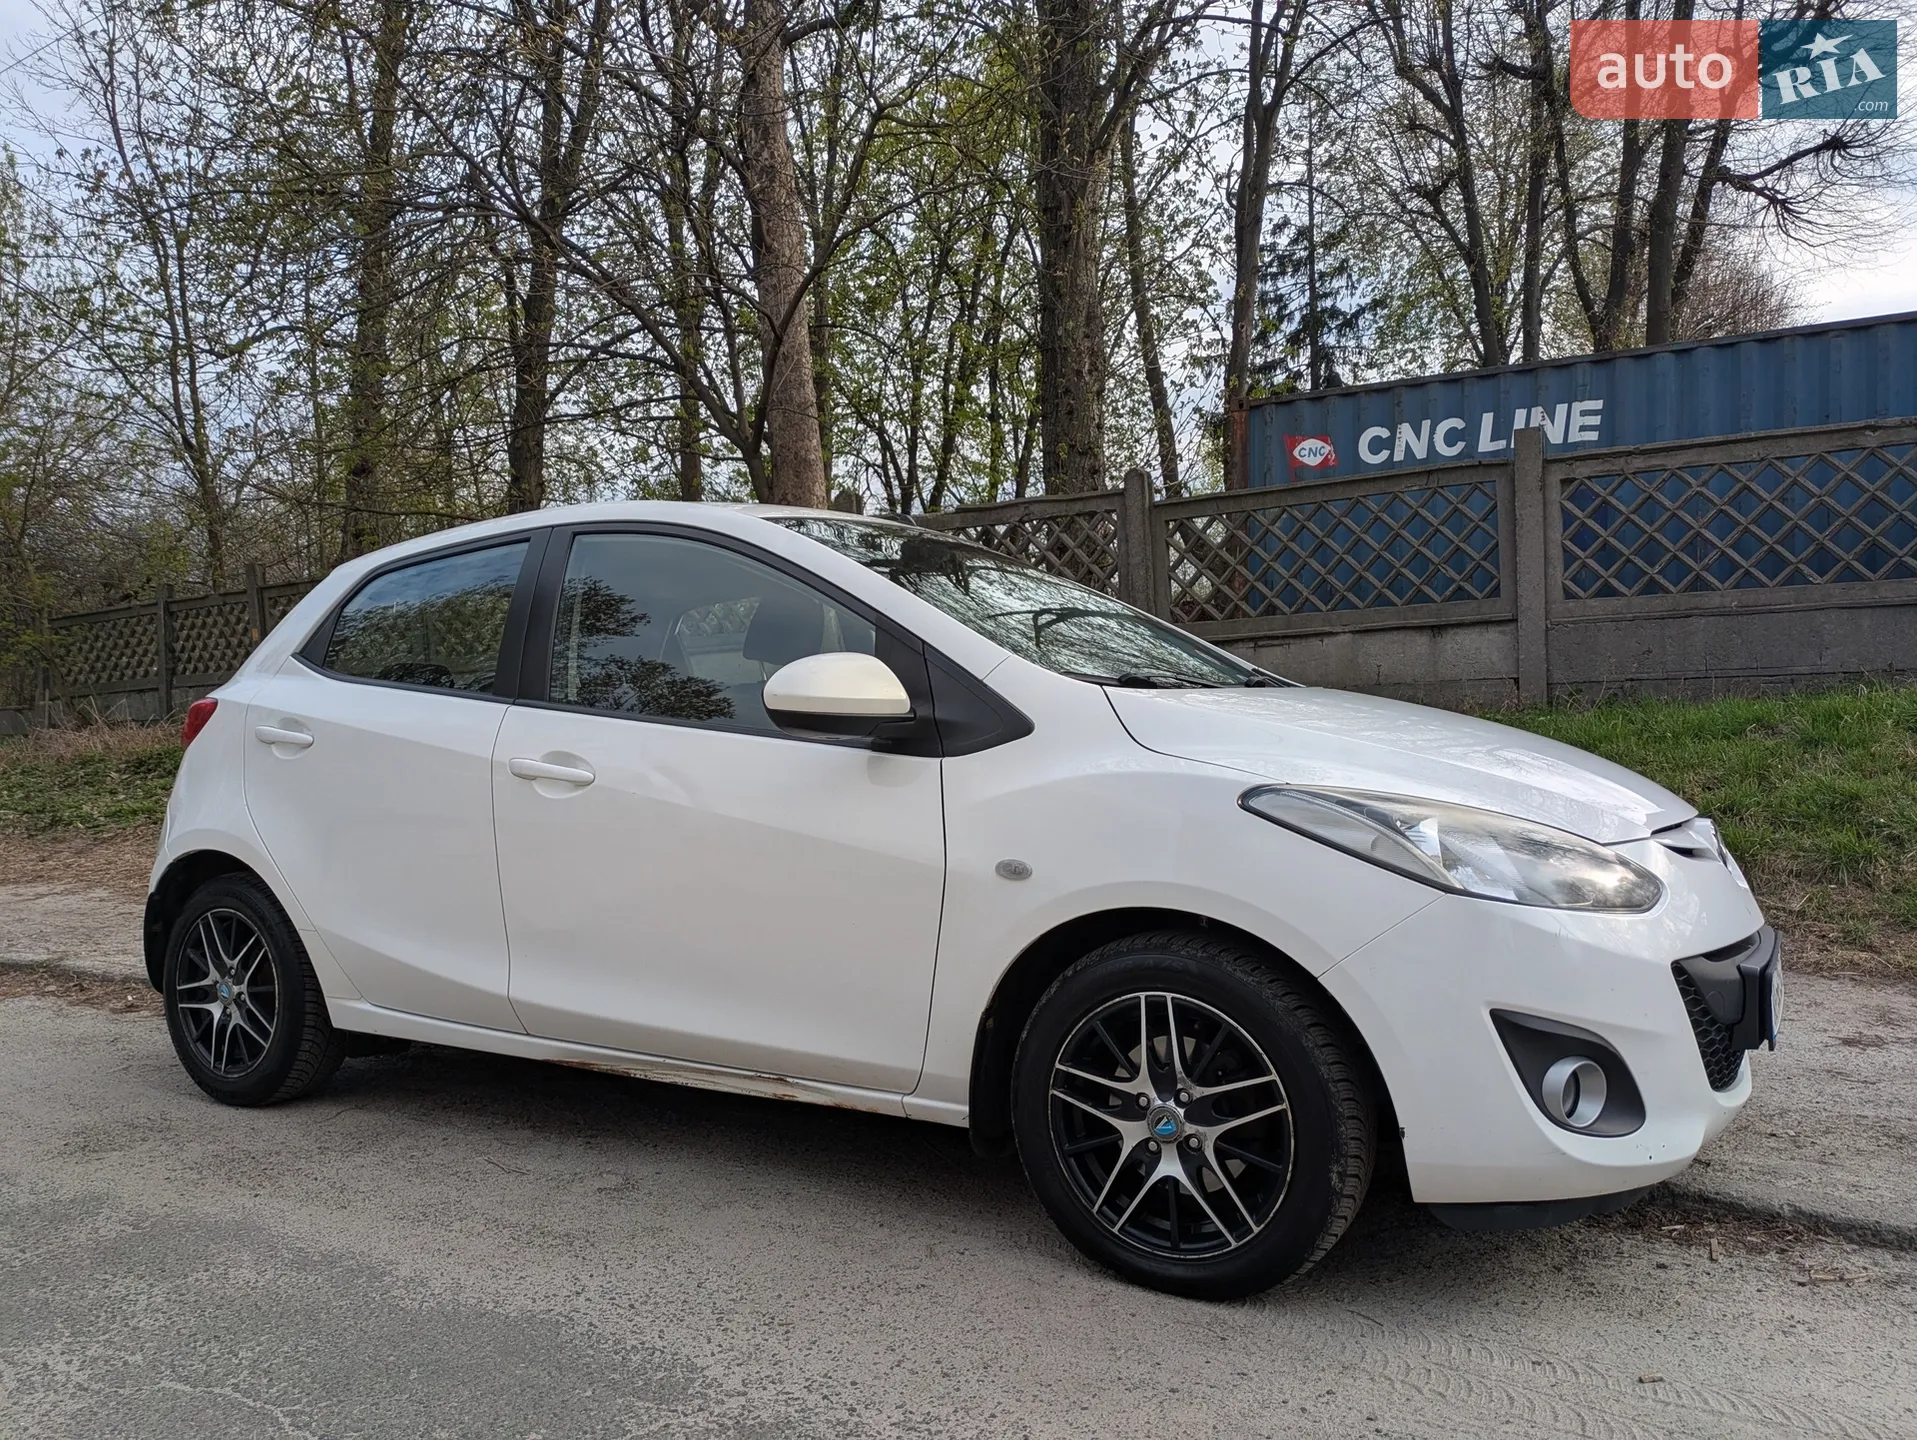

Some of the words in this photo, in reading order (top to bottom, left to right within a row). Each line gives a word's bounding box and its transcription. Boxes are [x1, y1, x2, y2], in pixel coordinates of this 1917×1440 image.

[1358, 417, 1467, 464] CNC
[1478, 399, 1603, 452] LINE
[1298, 445, 1326, 458] CNC
